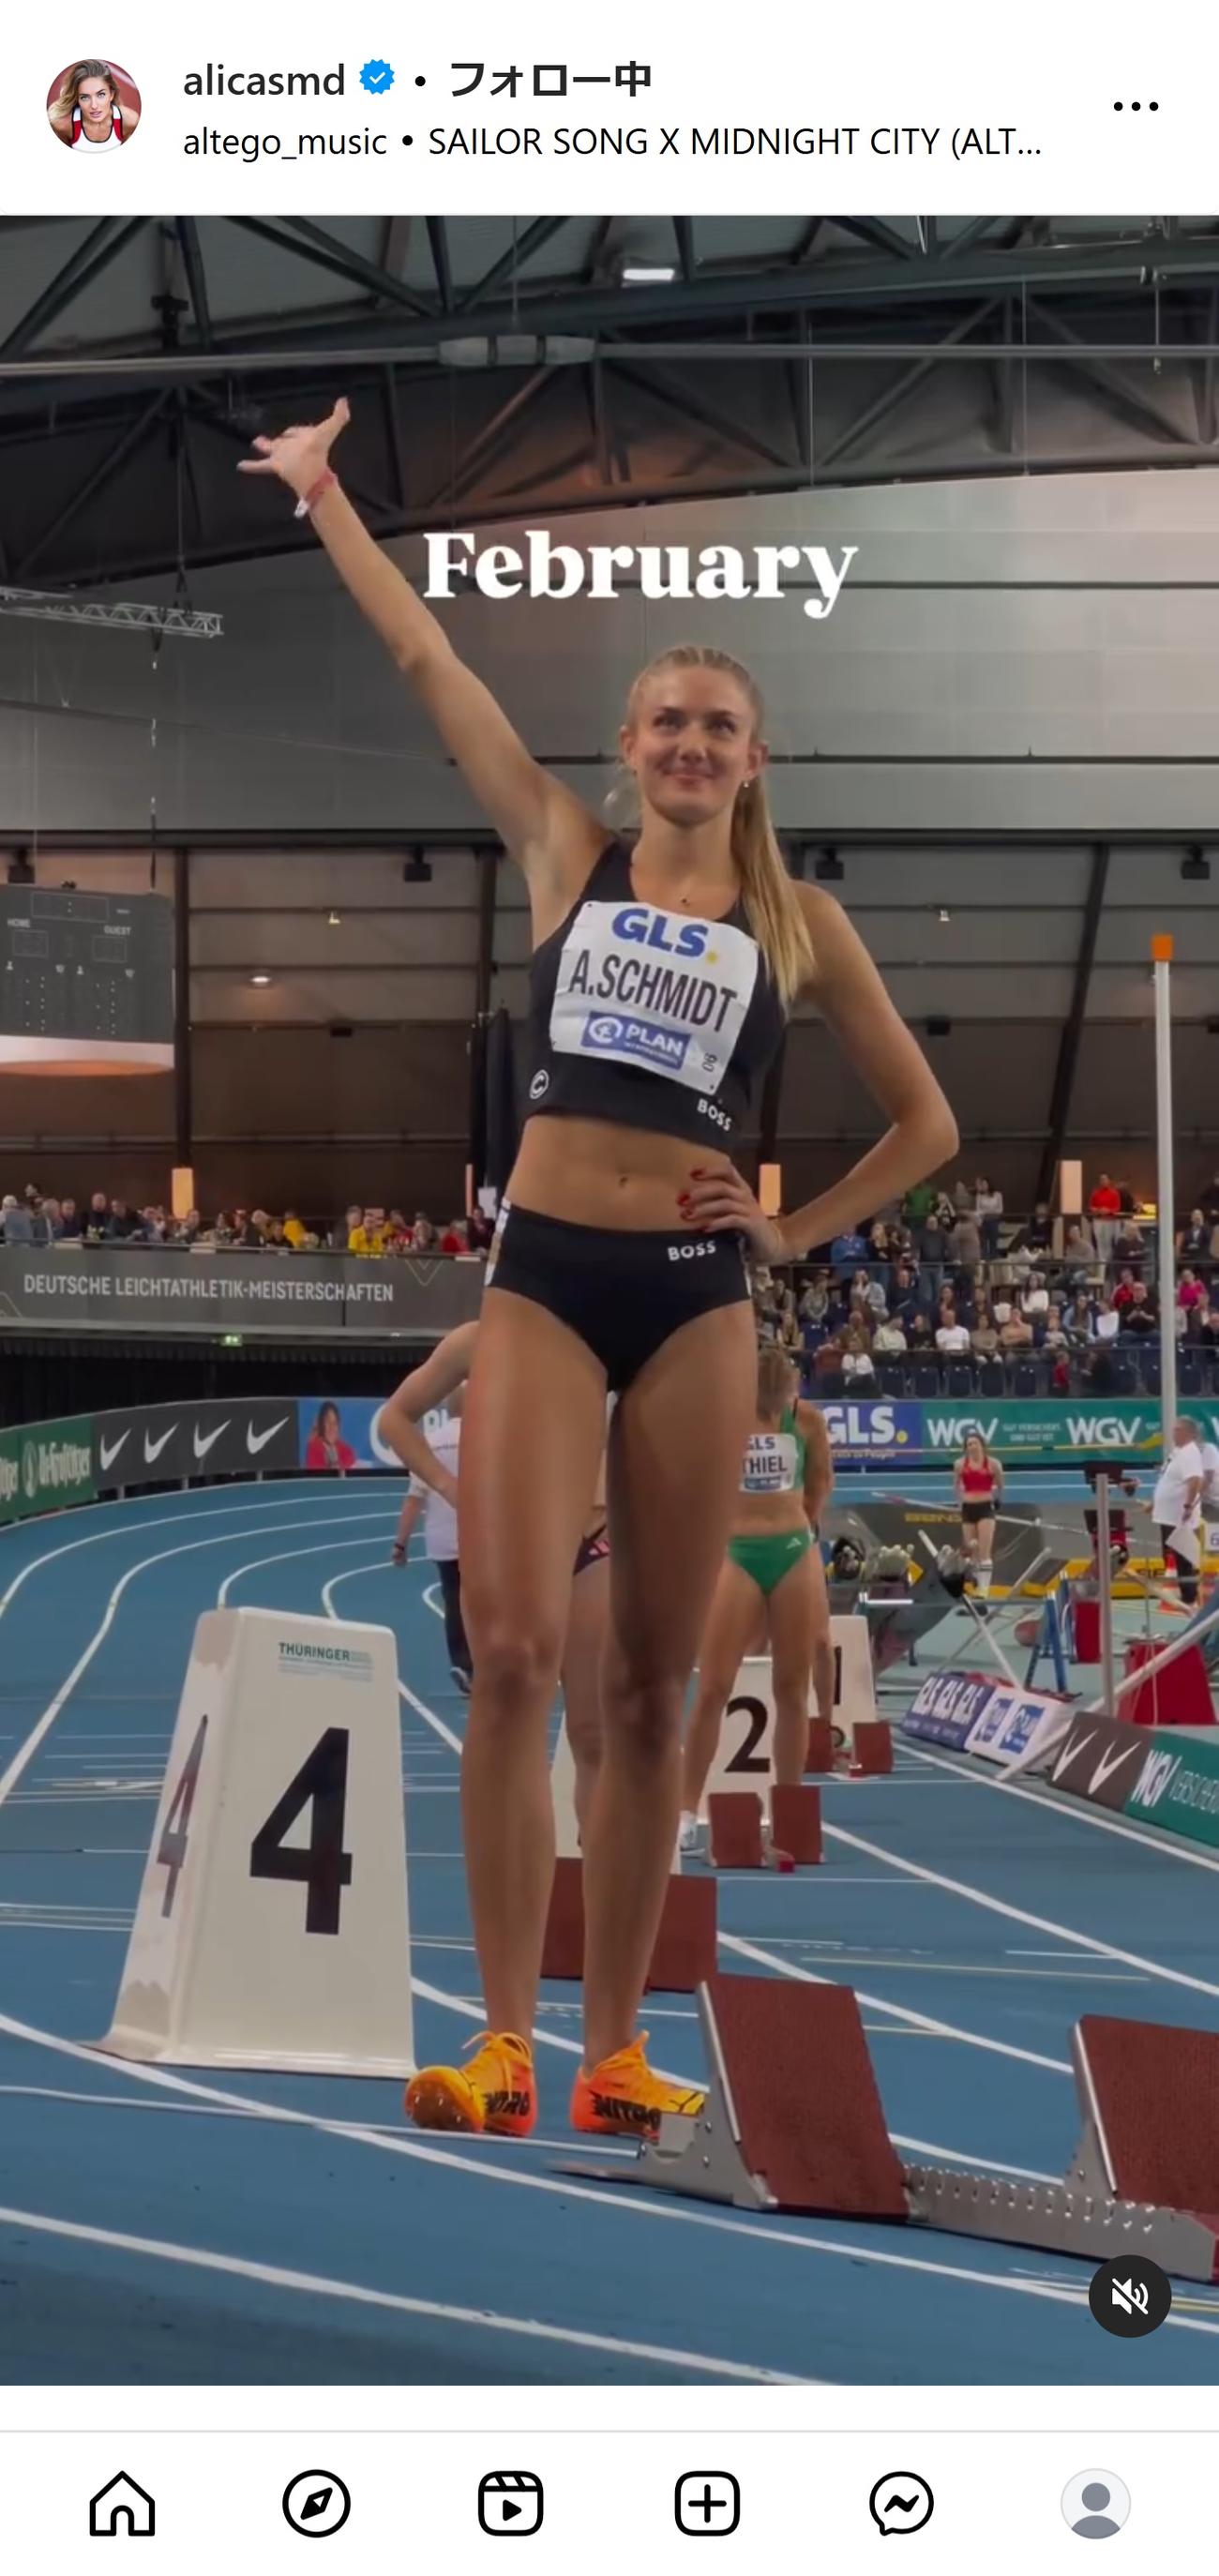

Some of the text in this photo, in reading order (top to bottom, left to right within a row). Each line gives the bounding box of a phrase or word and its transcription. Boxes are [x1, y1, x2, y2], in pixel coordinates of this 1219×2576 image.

[104, 925, 132, 936] GUEST
[568, 949, 738, 1032] A.SCHMIDT
[625, 1023, 684, 1056] PLAN
[697, 1098, 732, 1131] BOSS
[668, 1240, 716, 1261] BOSS
[23, 1273, 394, 1302] DEUTSCHE LEICHTATHLETIK-MEISTERSCHAFTEN
[926, 1417, 1000, 1447] WGV
[1065, 1417, 1141, 1445] WGV
[724, 1695, 771, 1773] 2
[157, 1714, 208, 1918] 4
[250, 1726, 353, 1936] 4
